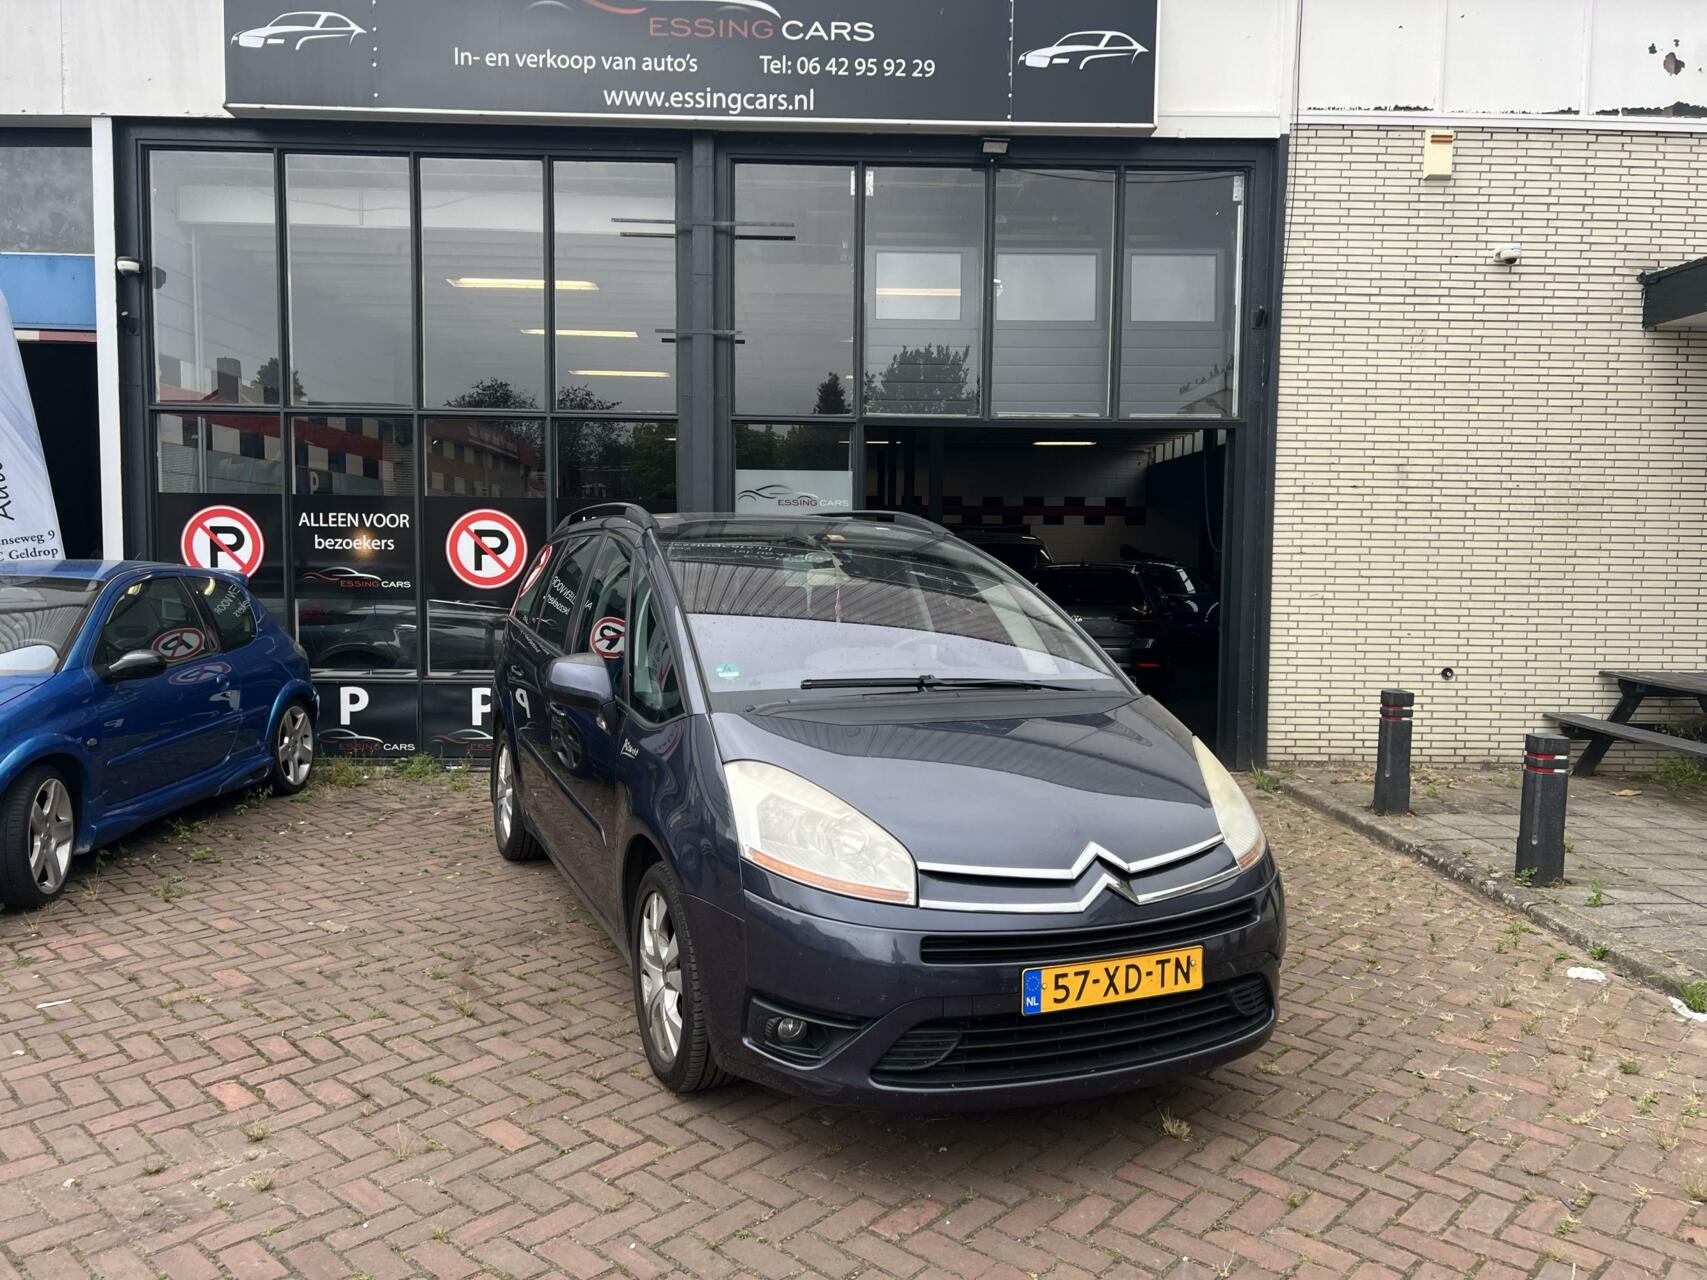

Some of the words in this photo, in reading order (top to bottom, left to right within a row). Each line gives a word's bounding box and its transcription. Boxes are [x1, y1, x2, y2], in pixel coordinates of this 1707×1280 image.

[649, 17, 773, 39] ESSING
[781, 20, 875, 42] CARS
[453, 47, 481, 66] In-
[484, 52, 511, 67] en
[514, 48, 597, 75] verkoop
[600, 56, 637, 72] van
[641, 53, 699, 73] auto's
[759, 55, 792, 75] Tel:
[796, 57, 821, 75] 06
[825, 58, 849, 76] 42
[854, 58, 878, 76] 95
[883, 59, 907, 77] 92
[911, 59, 936, 77] 29
[603, 88, 815, 113] www.essingcars.nl
[778, 499, 817, 507] ESSING
[819, 499, 849, 507] CARS
[298, 511, 359, 528] ALLEEN
[361, 513, 410, 528] VOOR
[48, 529, 56, 540] 9
[314, 534, 395, 550] bezoekers
[8, 547, 59, 560] Geldrop
[340, 580, 380, 588] ESSING
[381, 580, 412, 588] CARS
[340, 686, 369, 725] P
[383, 743, 416, 751] CARS
[1053, 955, 1192, 1004] 57-XD-TN
[1026, 996, 1039, 1007] NL
